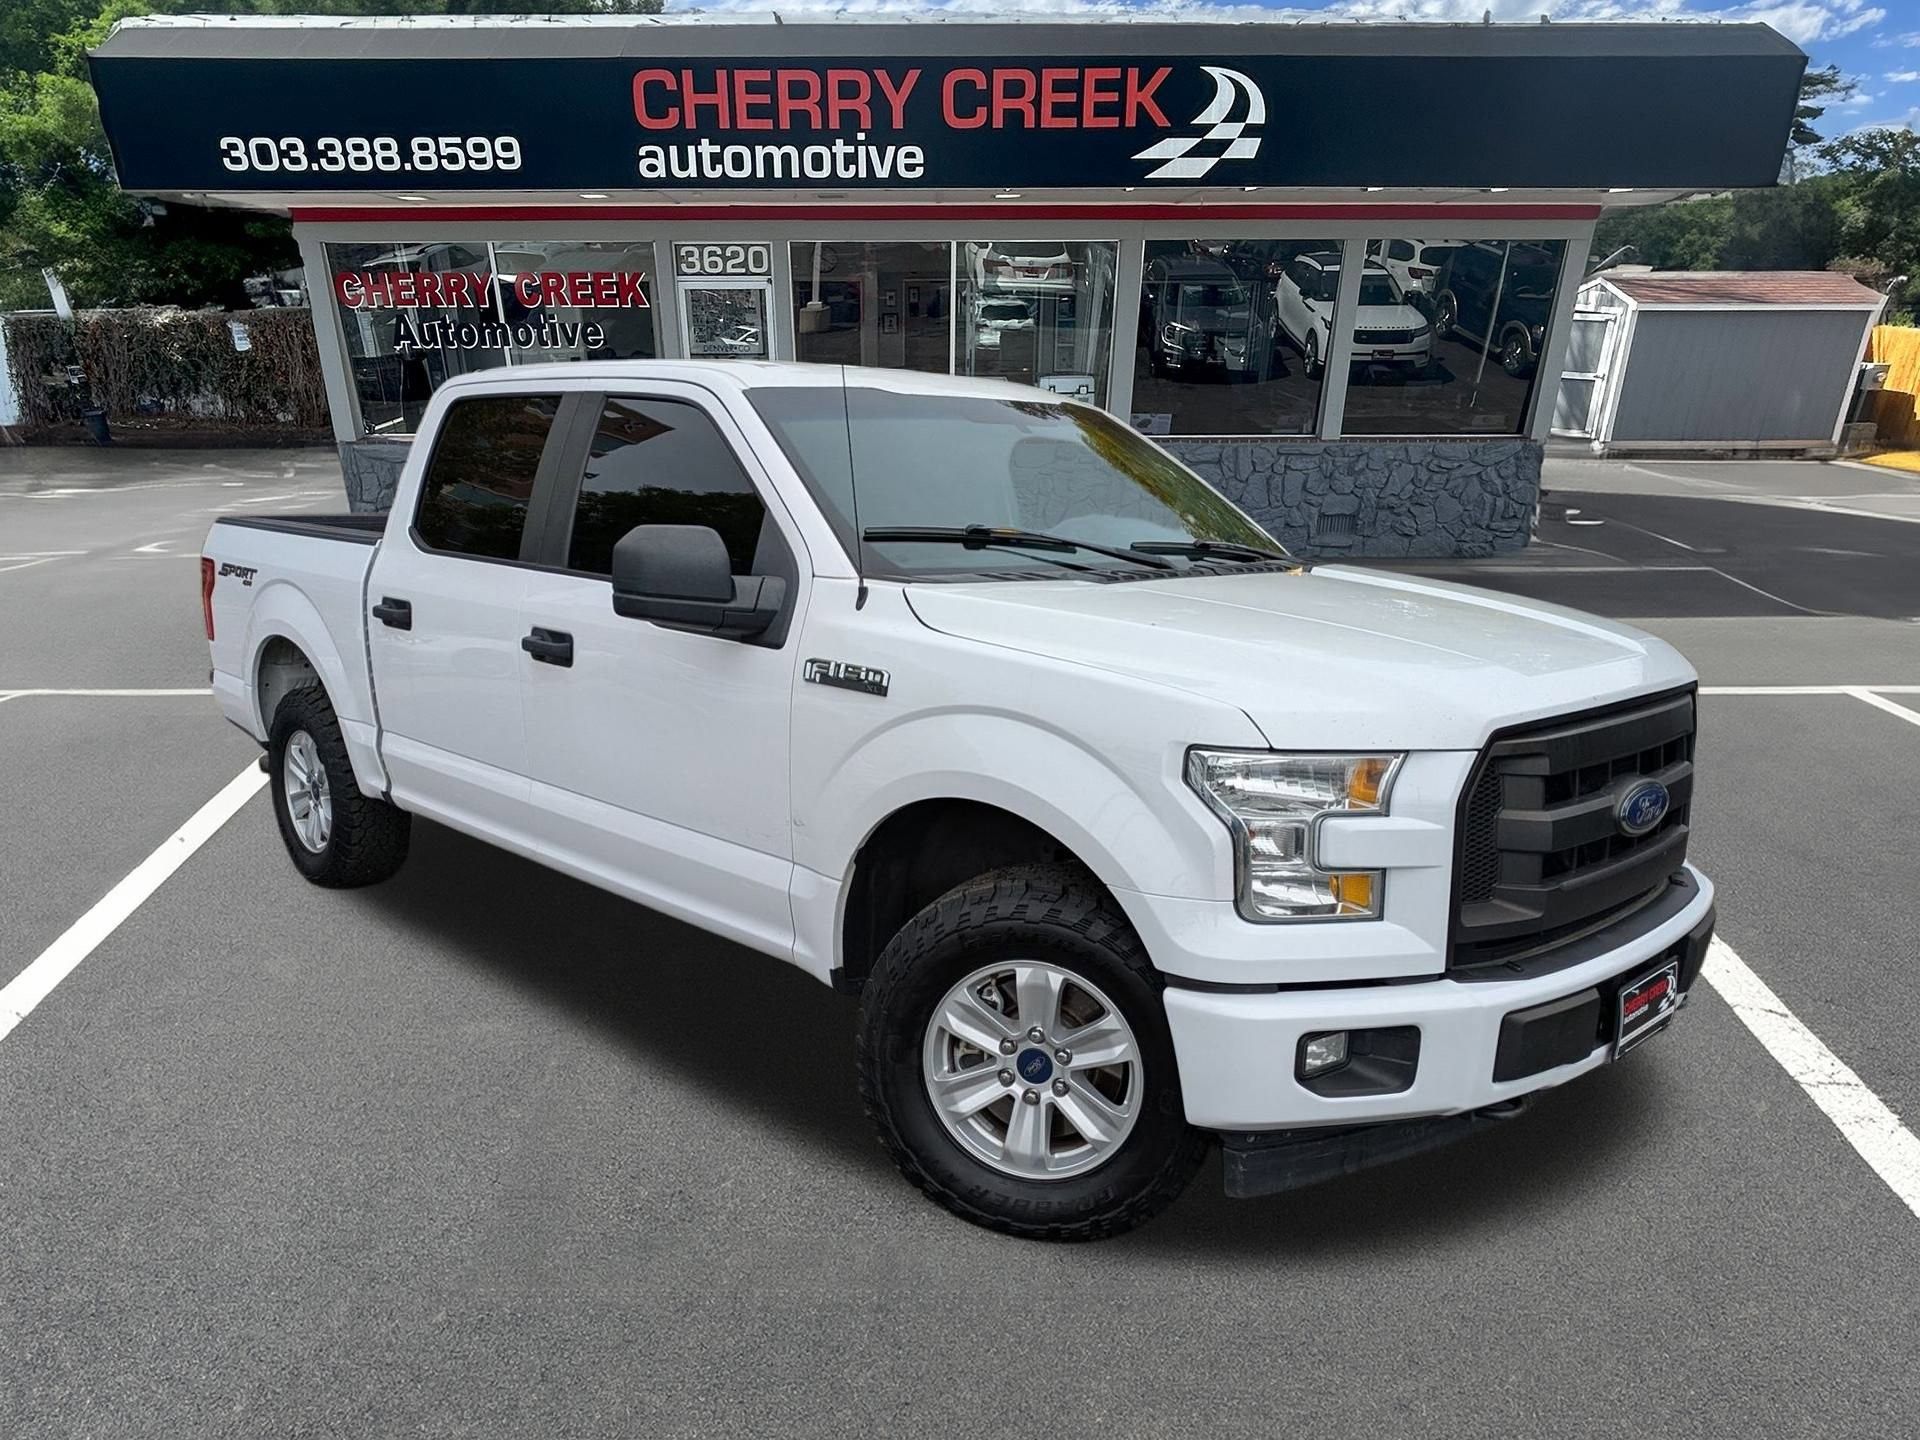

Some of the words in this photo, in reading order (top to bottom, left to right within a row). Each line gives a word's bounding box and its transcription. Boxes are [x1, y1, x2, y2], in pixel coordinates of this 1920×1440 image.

[632, 68, 921, 130] CHERRY
[942, 67, 1173, 129] CREEK
[219, 136, 522, 172] 303.388.8599
[638, 132, 925, 179] automotive
[680, 245, 768, 274] 3620
[334, 271, 494, 309] CHERRY
[514, 271, 651, 308] CREEK
[394, 313, 605, 350] Automotive
[218, 562, 258, 580] SPORT
